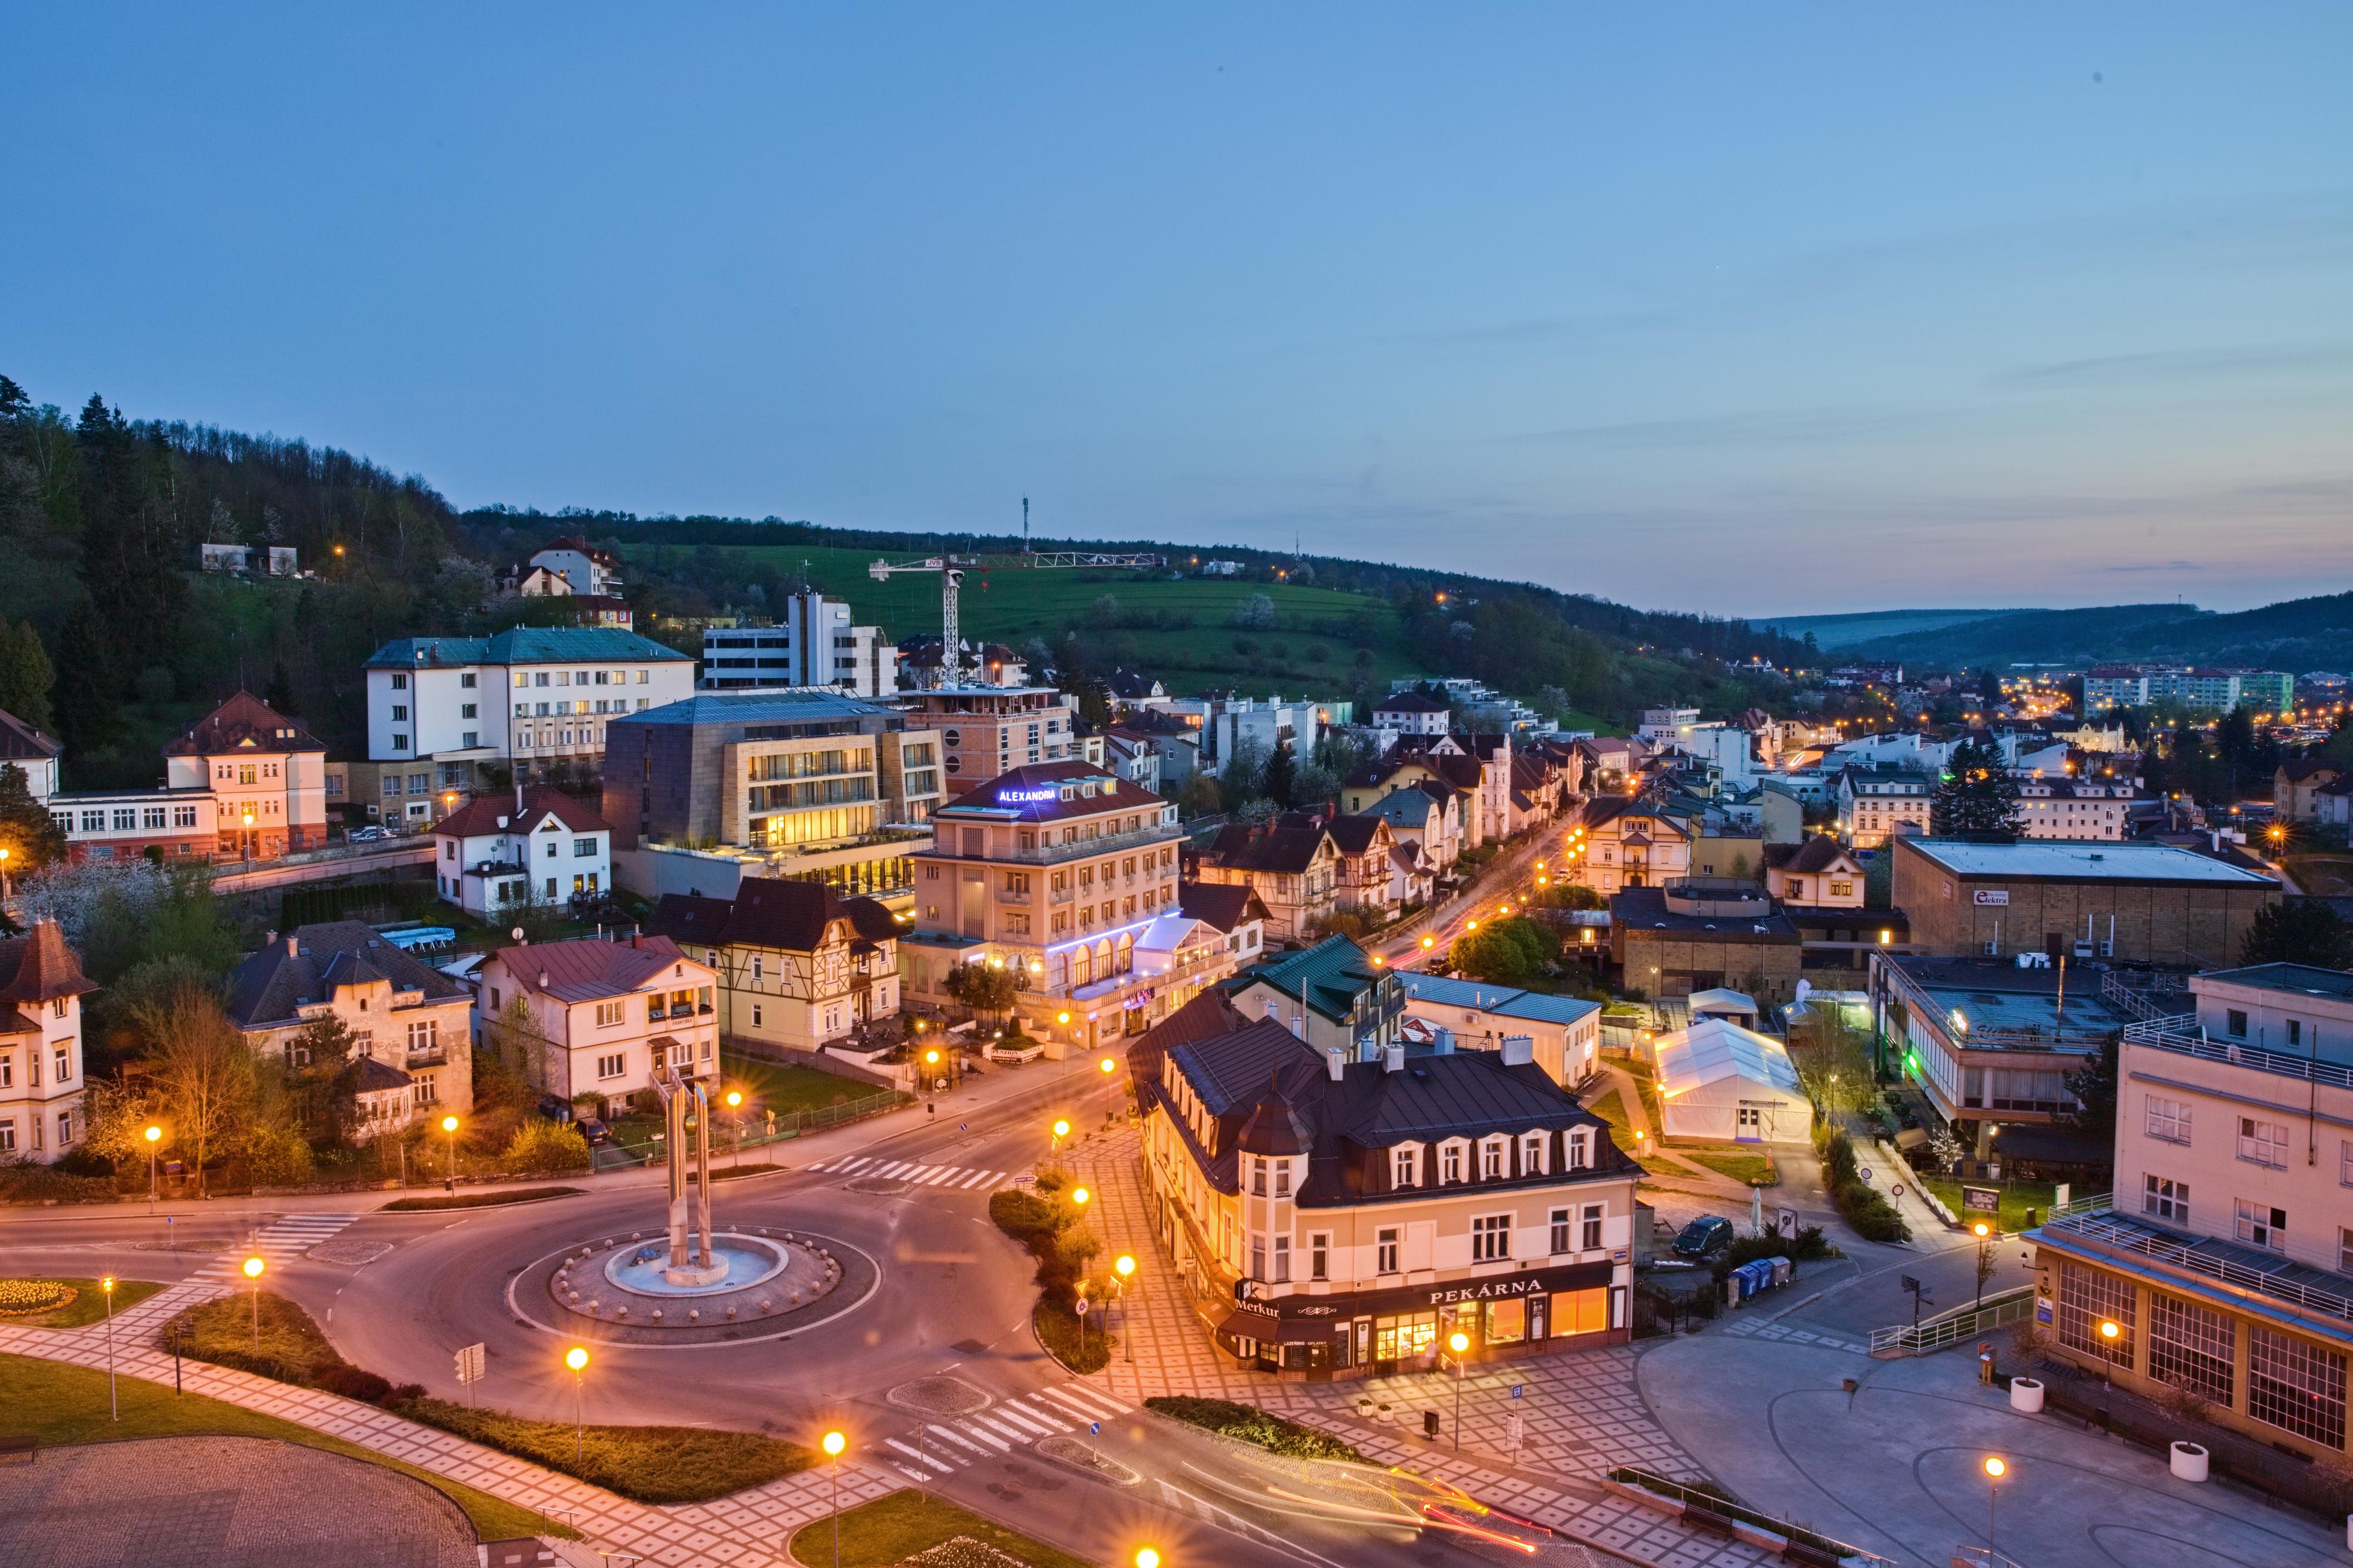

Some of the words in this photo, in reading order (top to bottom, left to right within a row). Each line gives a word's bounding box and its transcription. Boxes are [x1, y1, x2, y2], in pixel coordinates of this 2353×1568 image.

[1000, 789, 1055, 801] ALEXANDRIA
[1023, 1046, 1040, 1055] MONIKA
[1430, 1279, 1542, 1304] PEKÁRNA
[1236, 1299, 1279, 1318] Merkur
